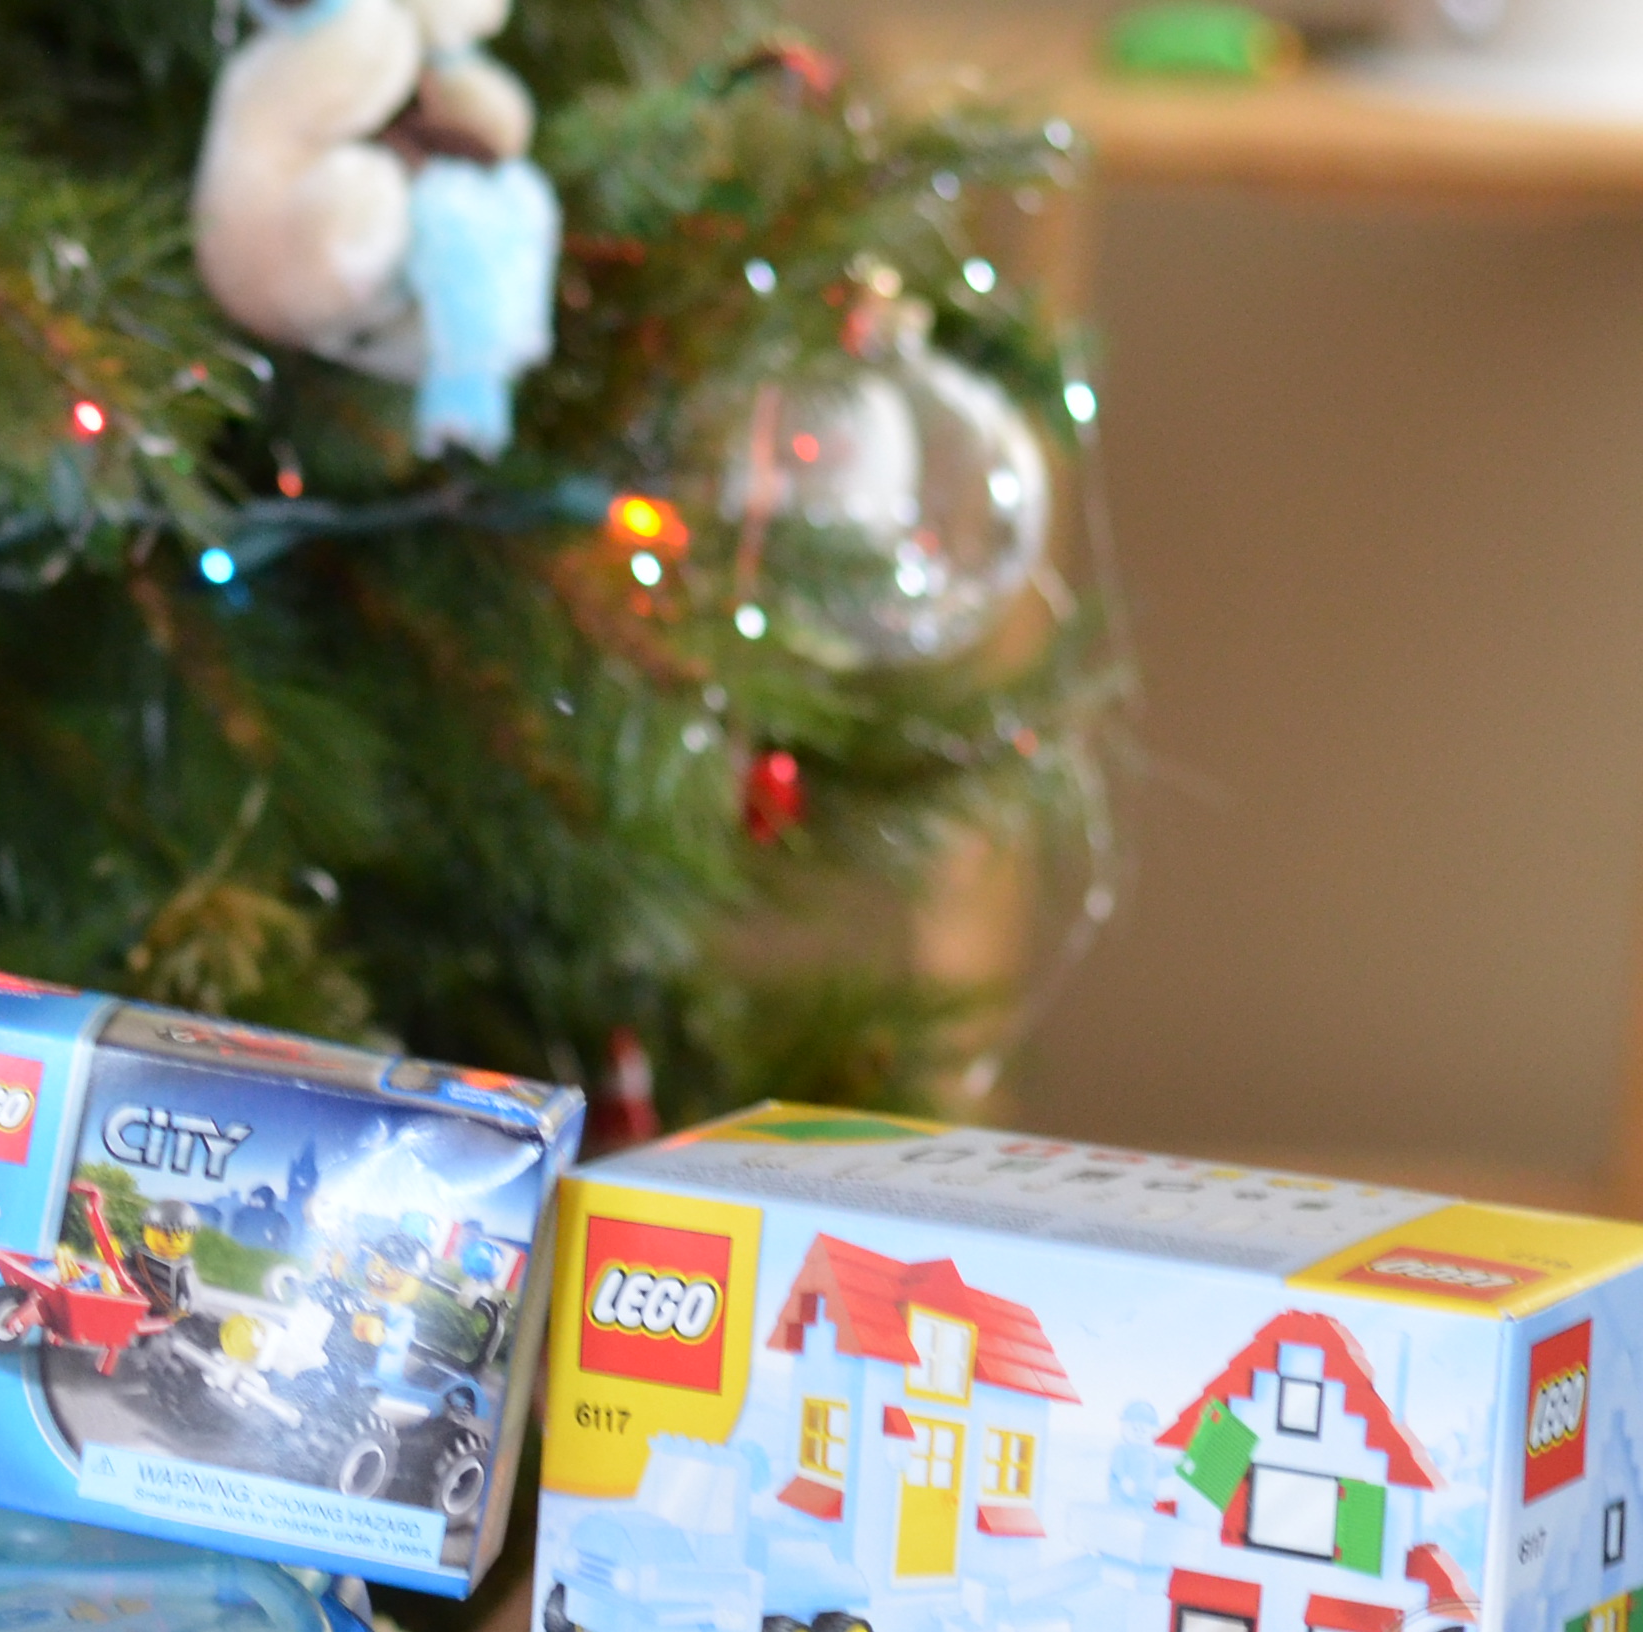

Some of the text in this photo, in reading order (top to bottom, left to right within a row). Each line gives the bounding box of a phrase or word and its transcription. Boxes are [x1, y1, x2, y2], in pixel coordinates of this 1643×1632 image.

[589, 1263, 720, 1342] LEGO
[574, 1401, 632, 1435] 6117
[1528, 1366, 1587, 1453] LEGO
[137, 1460, 257, 1504] WARNING:
[260, 1493, 345, 1524] CHOKING
